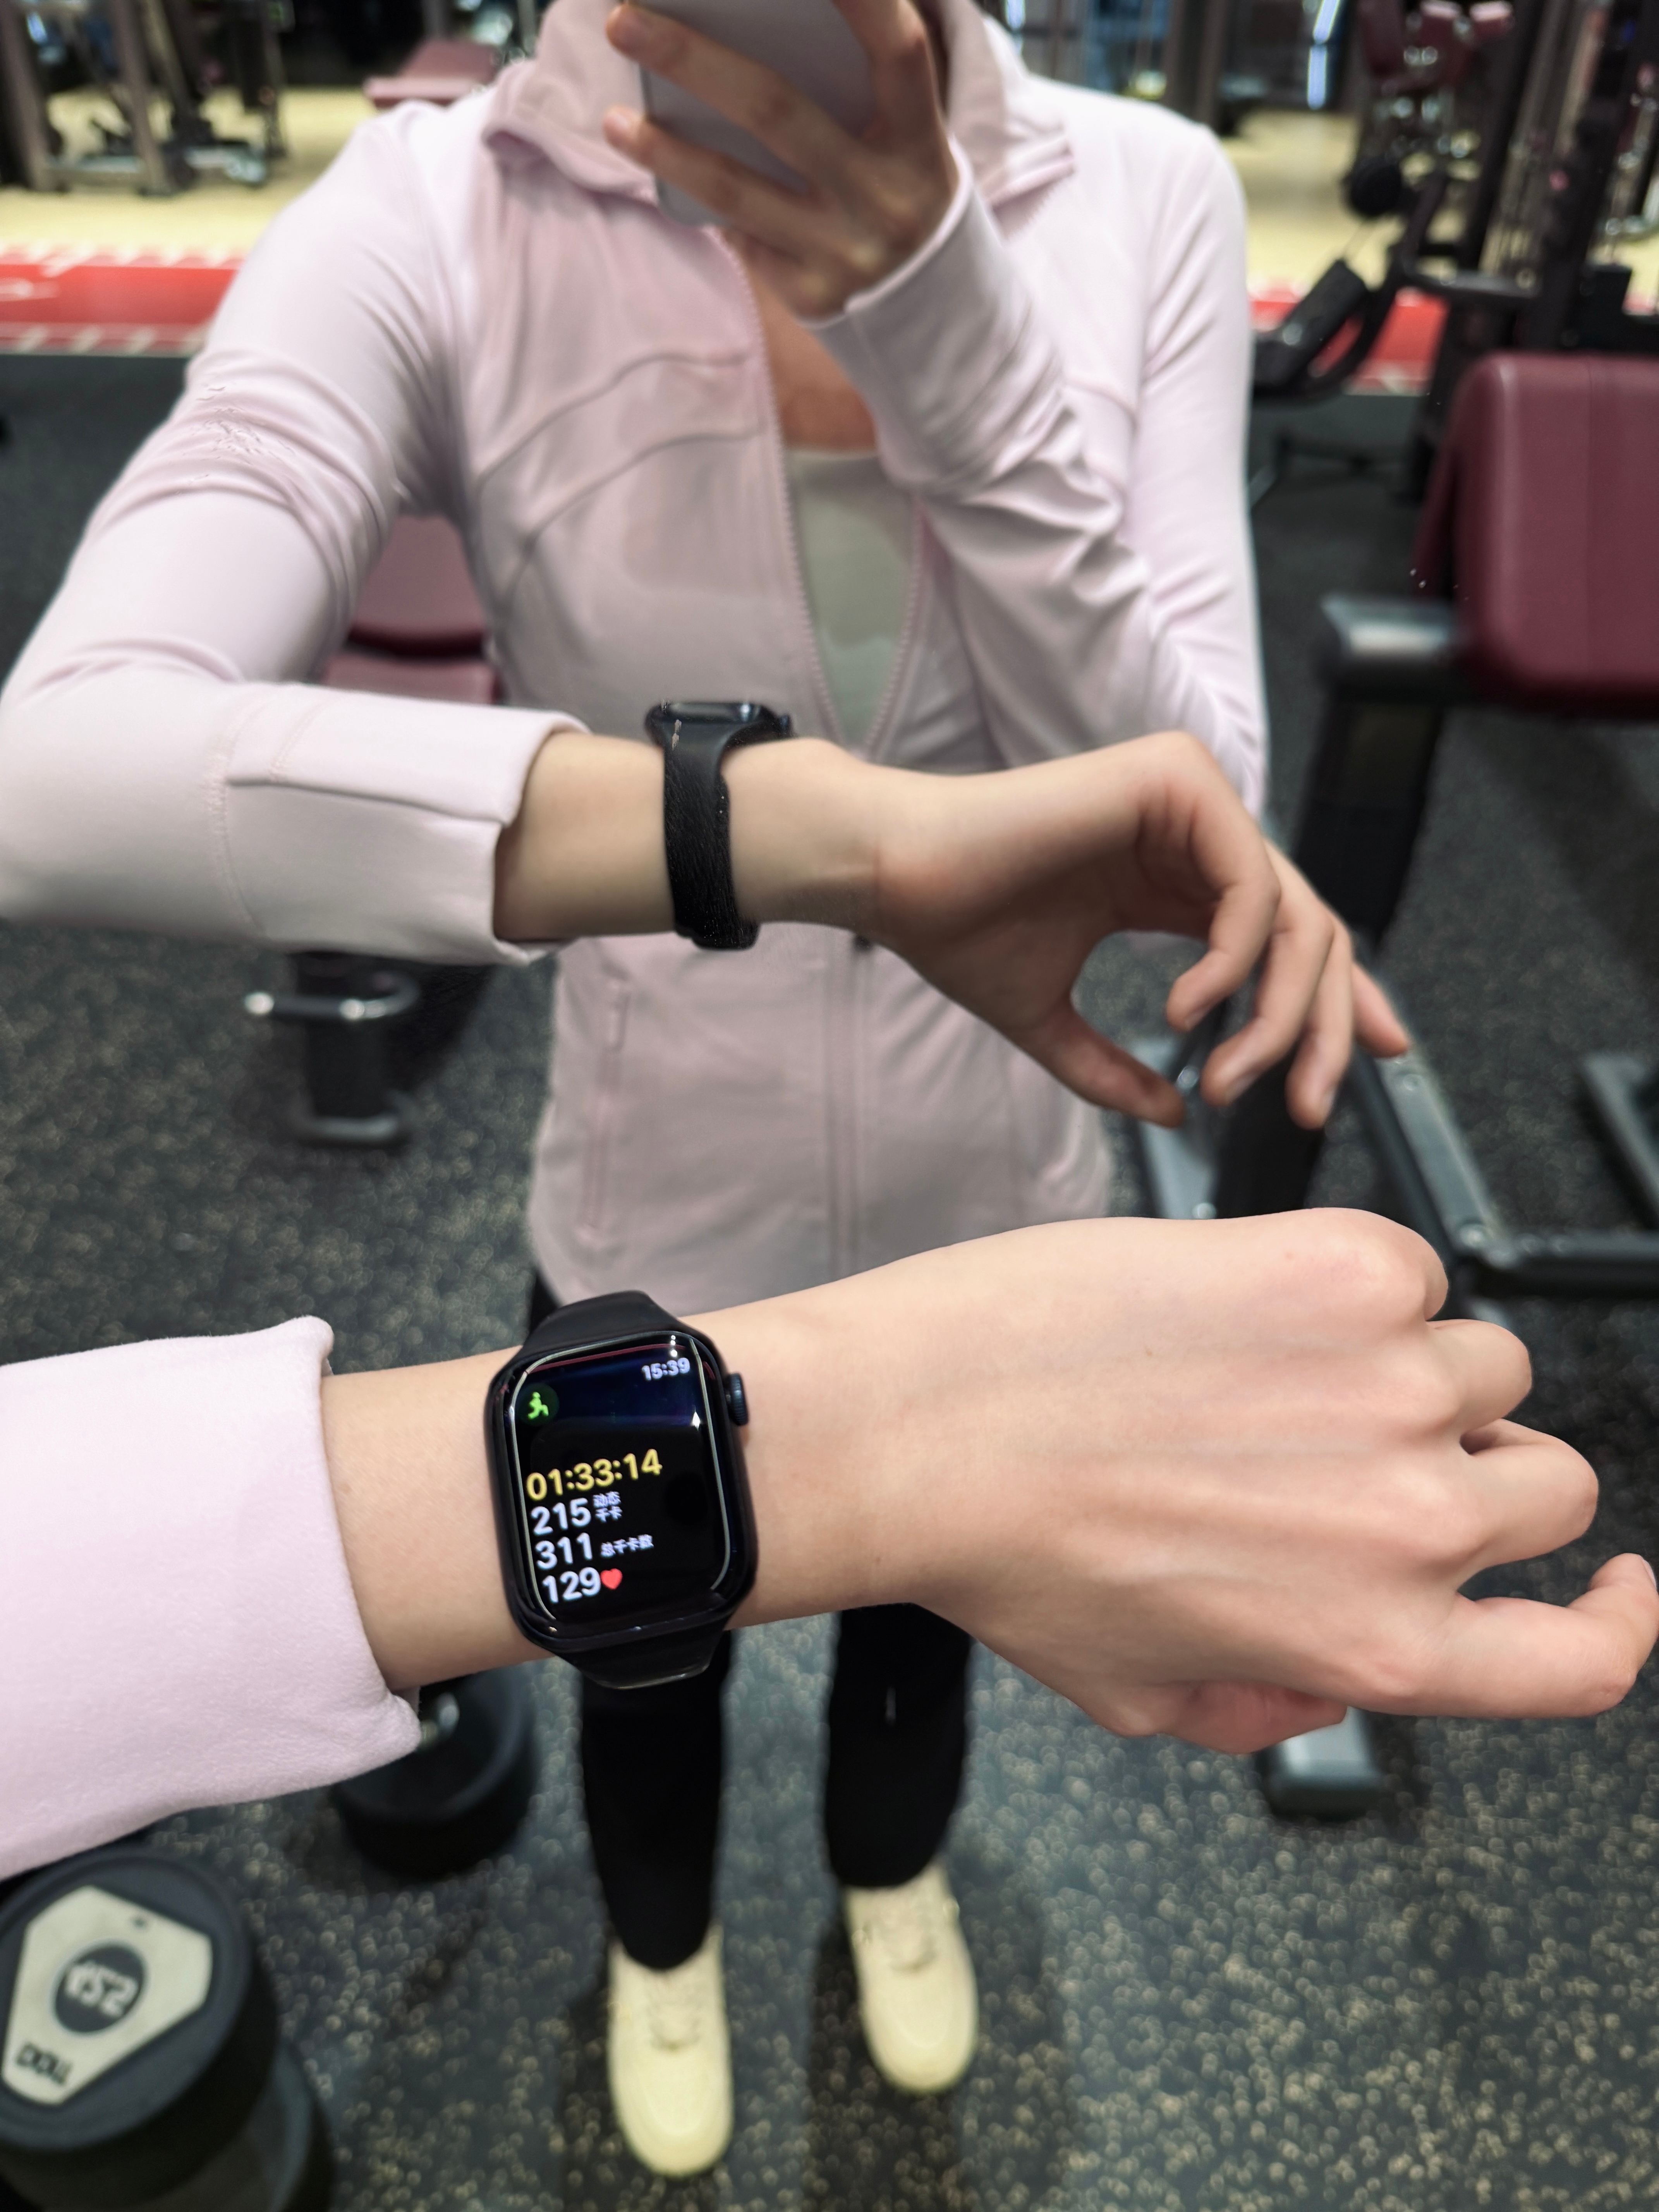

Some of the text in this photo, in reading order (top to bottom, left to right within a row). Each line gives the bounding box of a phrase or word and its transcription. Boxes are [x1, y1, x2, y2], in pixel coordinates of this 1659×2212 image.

[642, 1357, 690, 1381] 15:39
[526, 1449, 663, 1500] 01:33:14
[531, 1498, 591, 1535] 215
[535, 1532, 593, 1570] 311
[543, 1566, 601, 1604] 129
